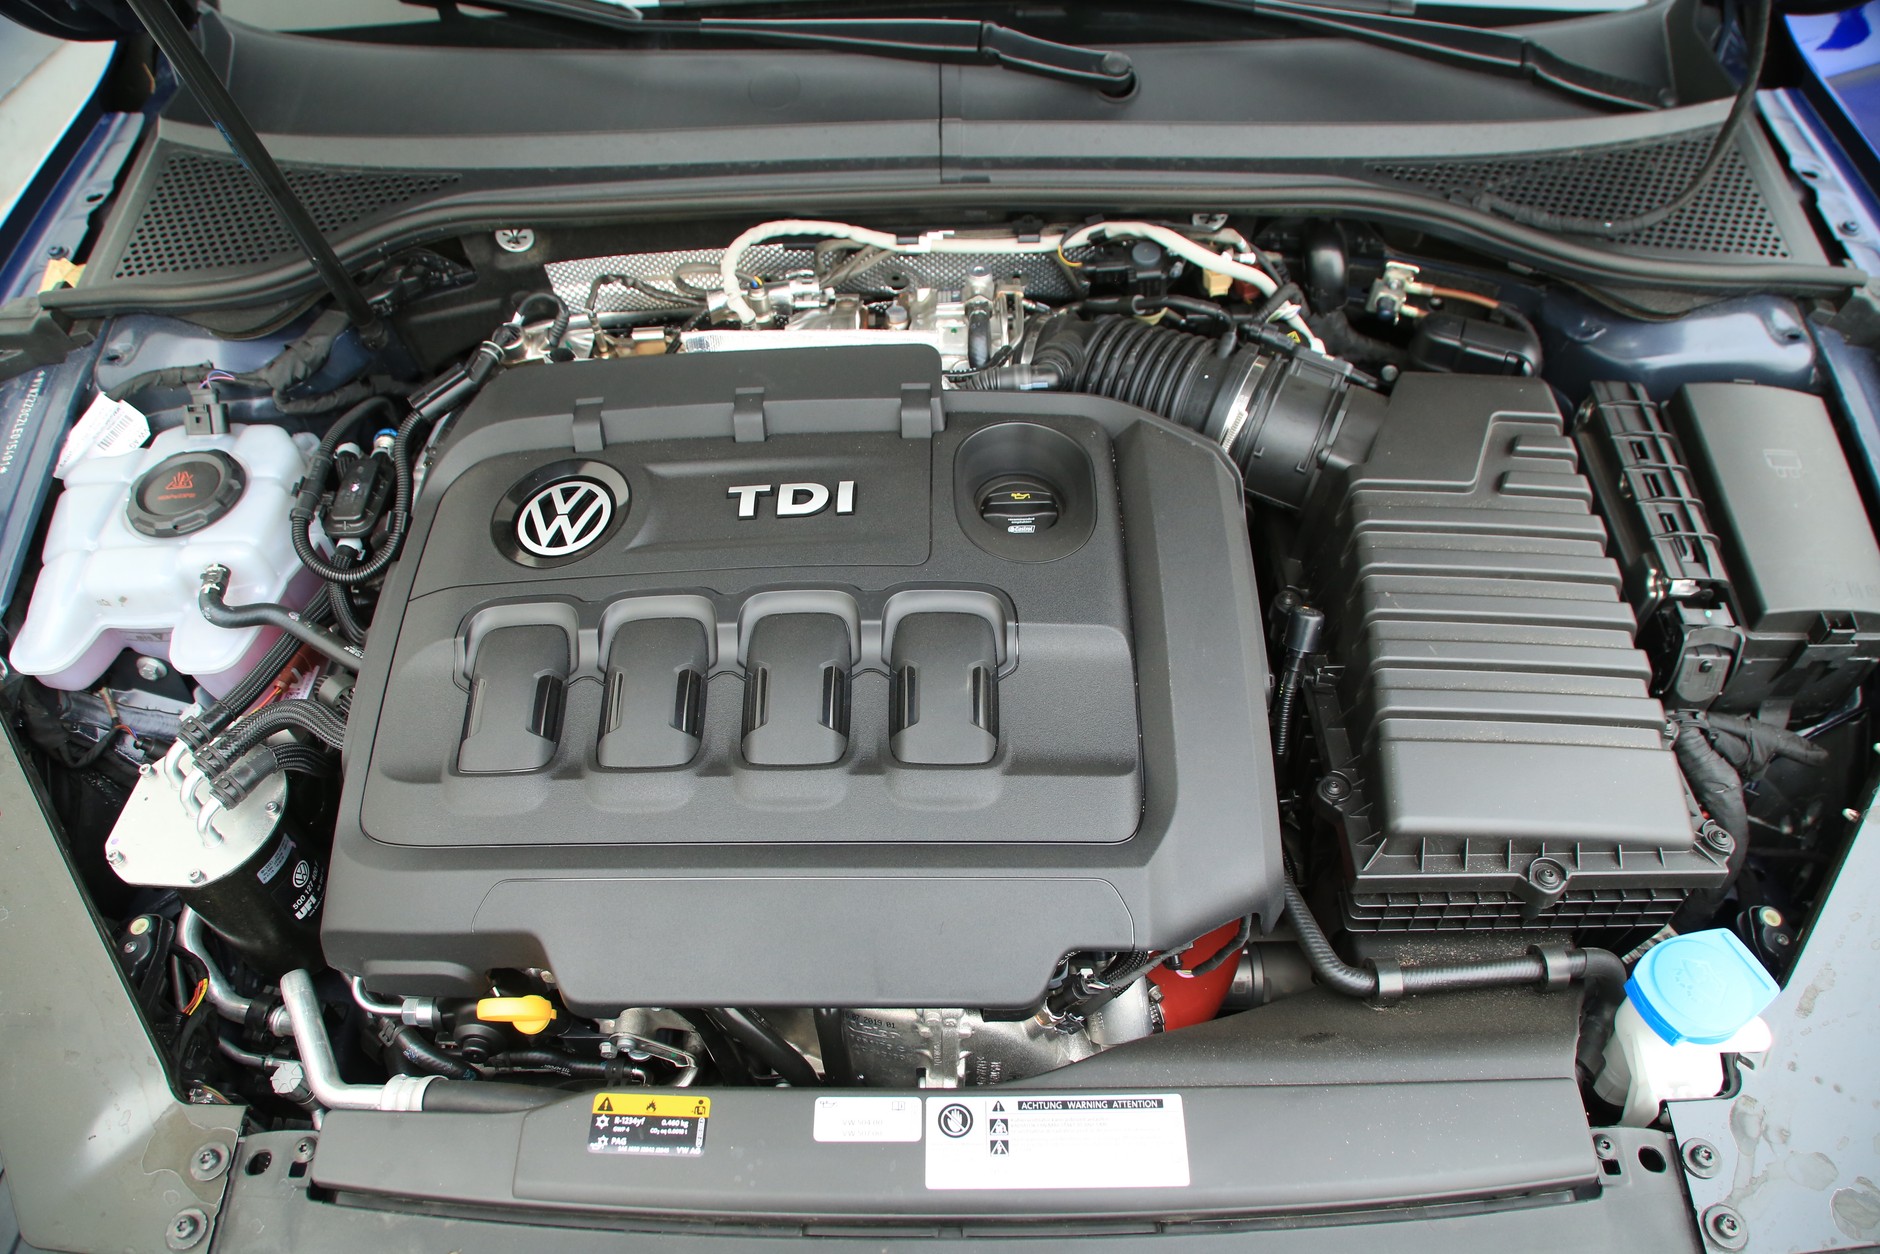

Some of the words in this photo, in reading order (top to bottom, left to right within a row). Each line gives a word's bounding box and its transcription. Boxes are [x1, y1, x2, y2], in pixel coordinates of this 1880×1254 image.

[728, 480, 855, 519] TDI
[305, 880, 314, 895] 127
[295, 894, 317, 920] UFI
[864, 1016, 883, 1027] 2019
[1021, 1100, 1063, 1110] ACHTUNG
[1067, 1100, 1108, 1109] WARNING
[1112, 1099, 1158, 1109] ATTENTION
[680, 1119, 689, 1128] kg
[611, 1137, 627, 1145] PAG
[676, 1146, 690, 1155] VW
[689, 1147, 701, 1155] AG
